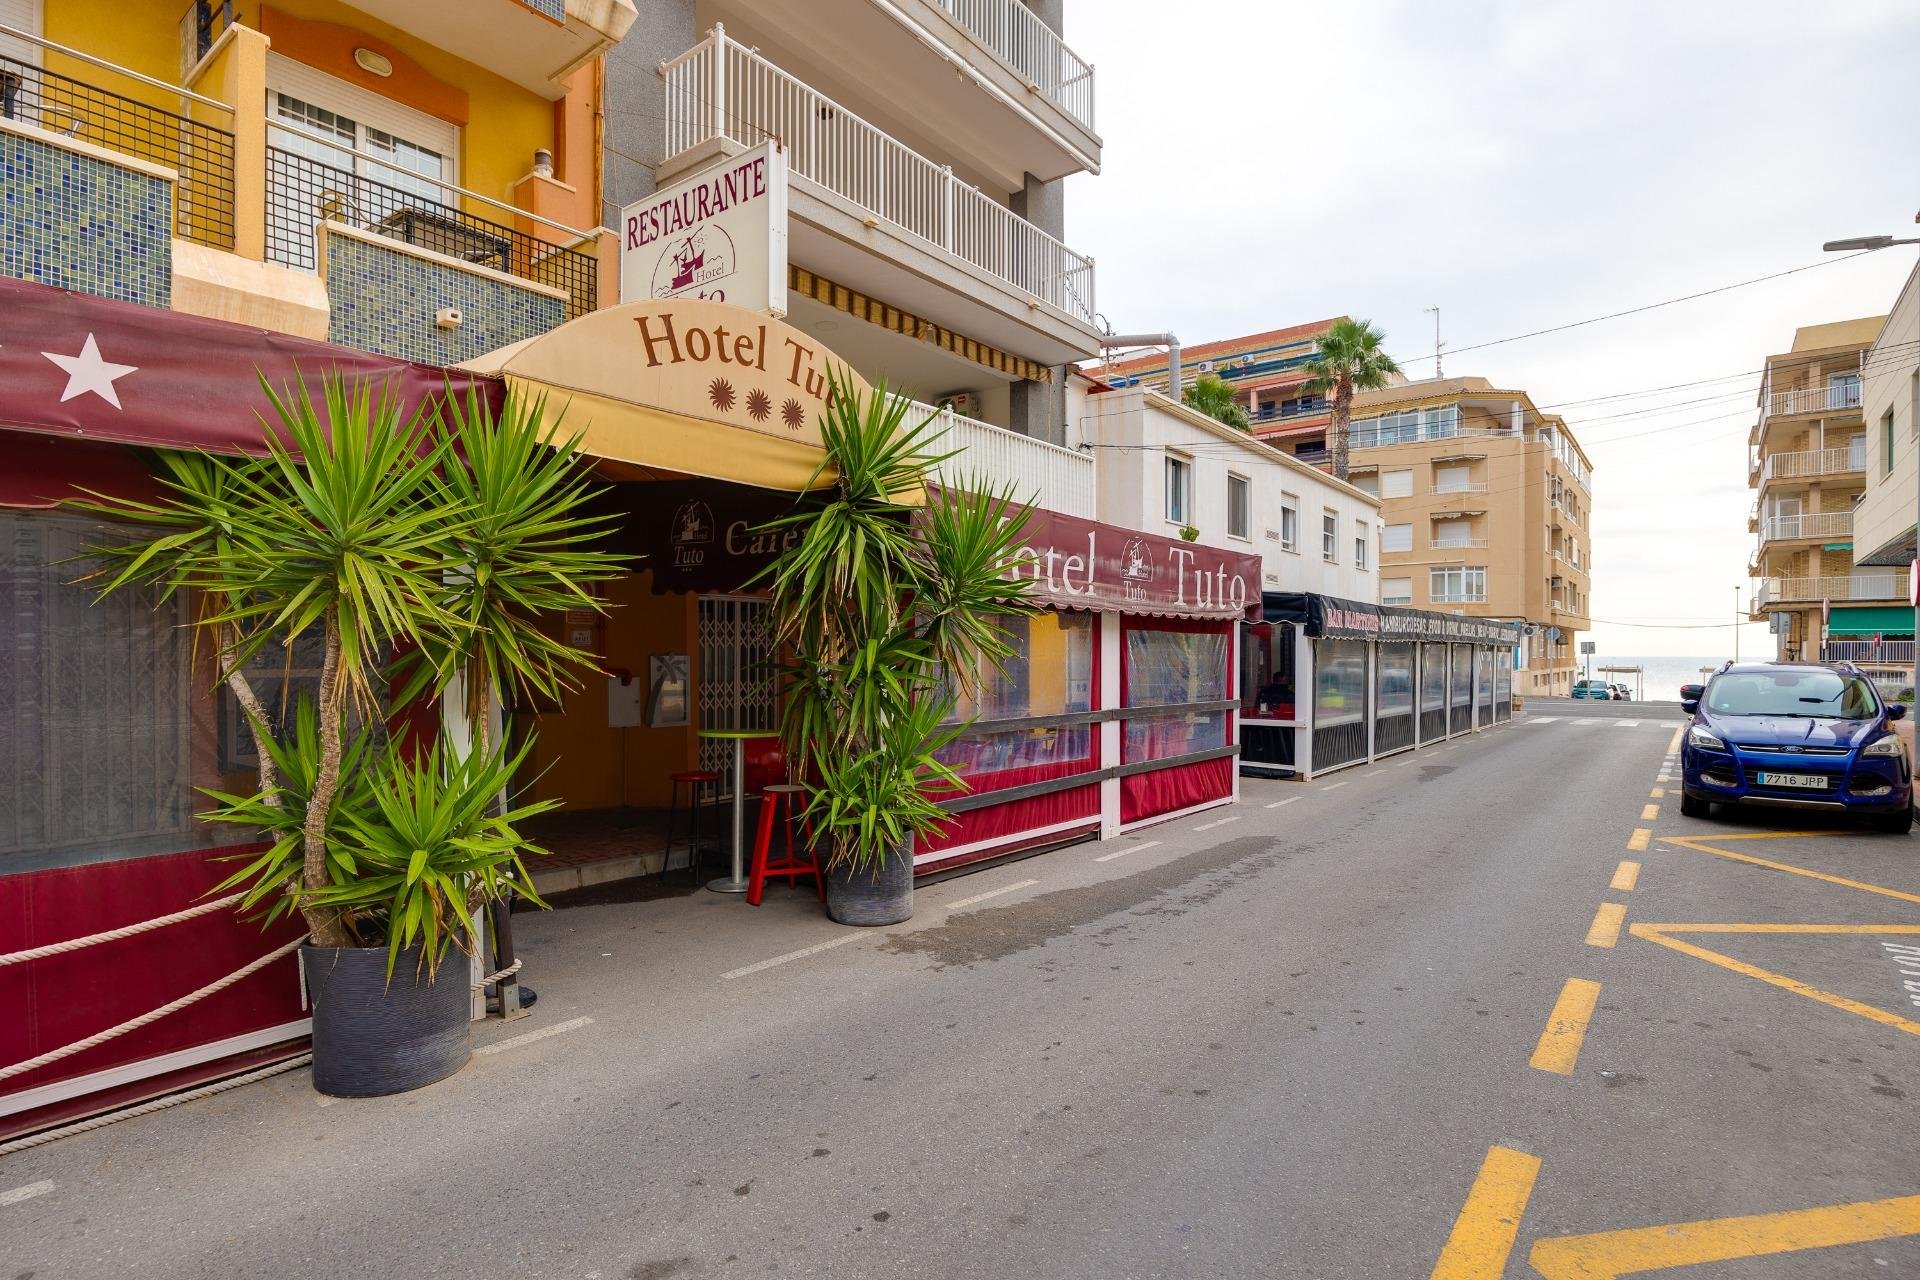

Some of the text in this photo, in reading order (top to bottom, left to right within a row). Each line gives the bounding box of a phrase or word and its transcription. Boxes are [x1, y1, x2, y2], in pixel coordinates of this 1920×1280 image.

[627, 156, 766, 251] RESTAURANTE
[696, 262, 725, 282] Hotel
[633, 313, 767, 372] Hotel
[673, 545, 704, 565] Tuto
[1169, 546, 1246, 610] Tuto
[1123, 580, 1147, 601] Tuto
[1766, 774, 1824, 787] 7716 JPP
